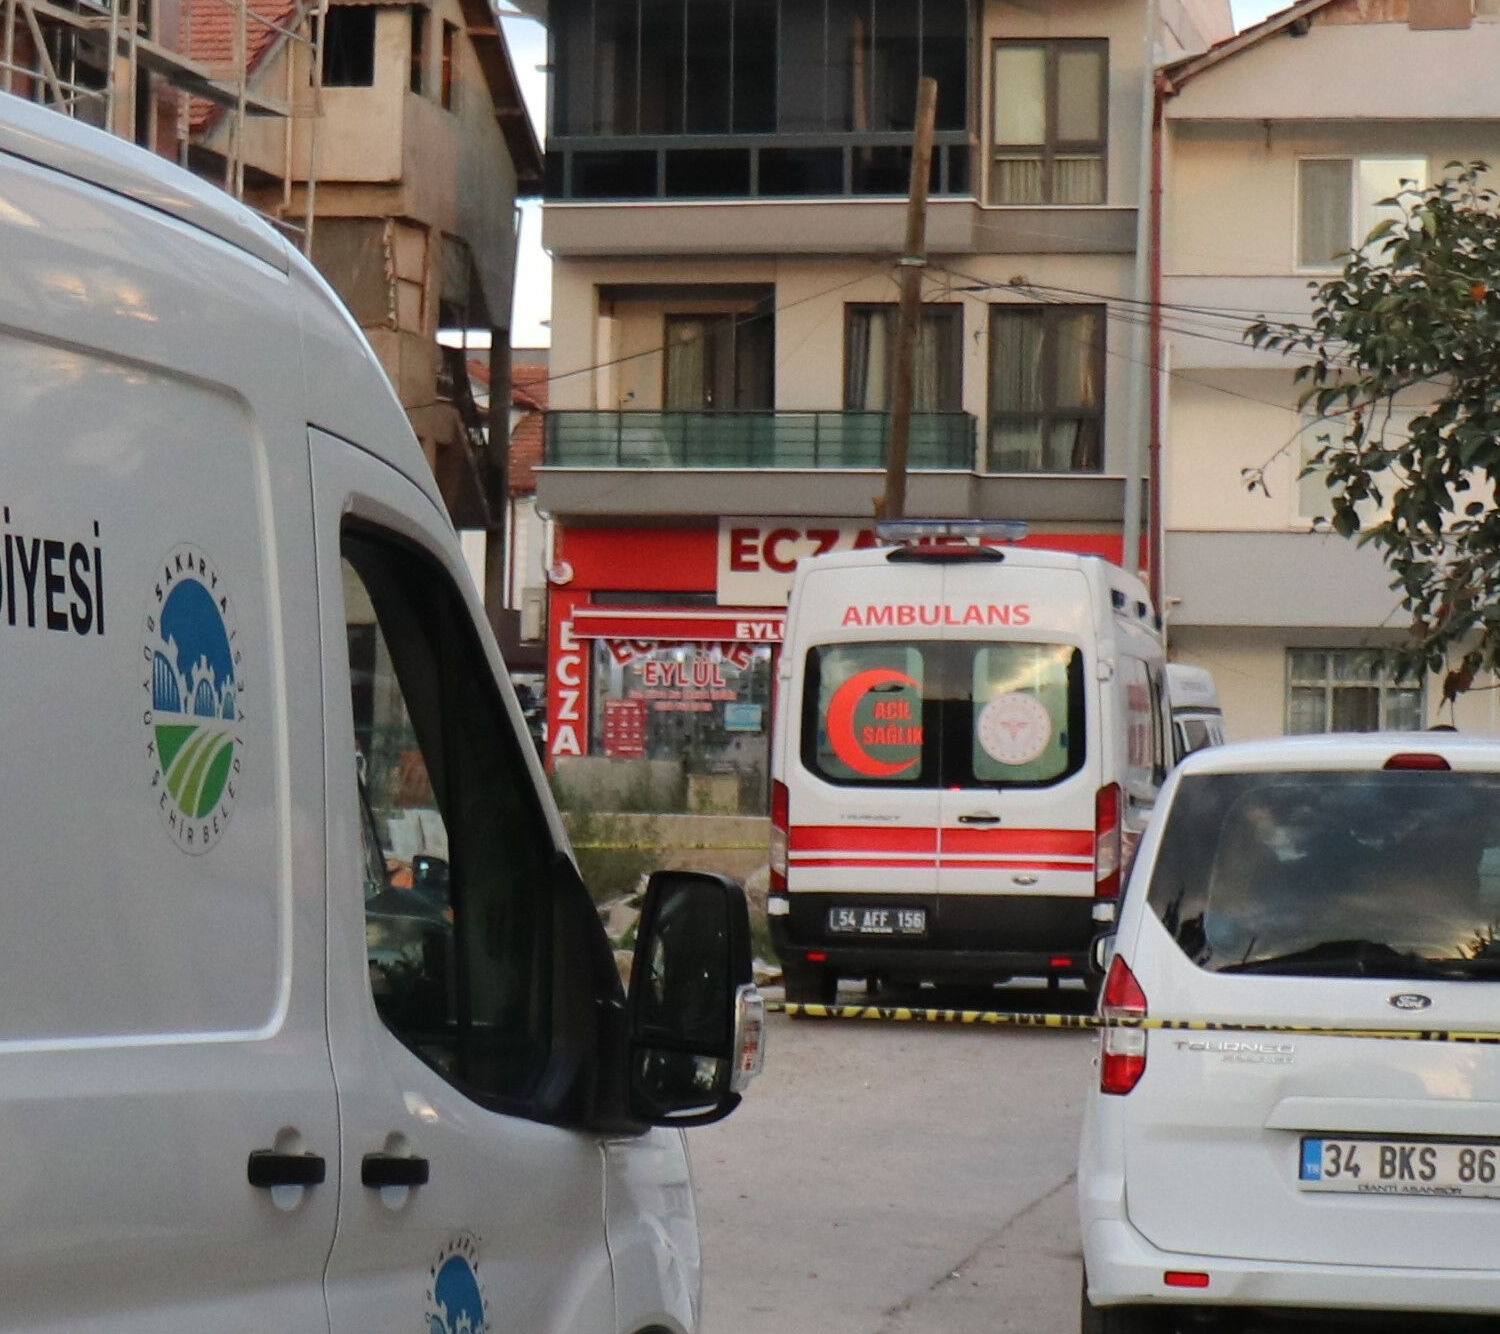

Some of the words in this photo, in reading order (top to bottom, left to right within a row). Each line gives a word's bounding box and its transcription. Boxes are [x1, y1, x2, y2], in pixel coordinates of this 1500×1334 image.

[154, 551, 228, 614] SAKARYA
[841, 603, 1032, 627] AMBULANS
[643, 657, 727, 687] EYLÜL
[838, 910, 856, 928] 54
[862, 910, 889, 928] AFF
[897, 910, 922, 928] 156
[1324, 1143, 1361, 1179] 34
[1378, 1145, 1438, 1182] BKS
